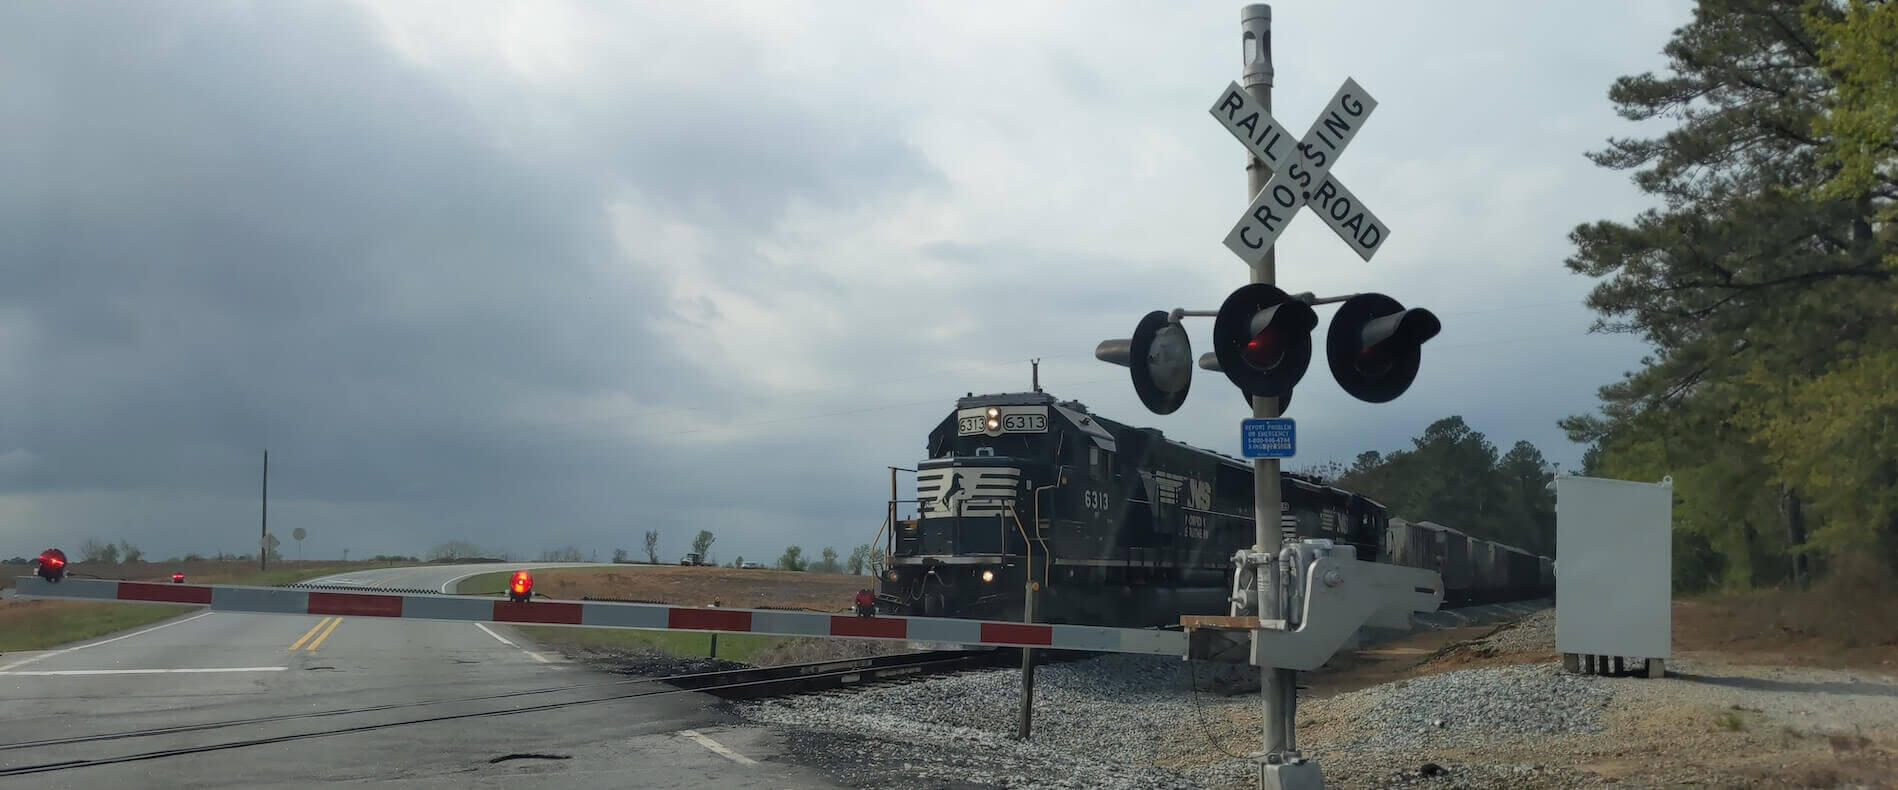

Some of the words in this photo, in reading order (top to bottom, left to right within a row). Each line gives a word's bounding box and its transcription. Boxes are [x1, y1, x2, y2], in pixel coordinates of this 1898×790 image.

[1219, 90, 1281, 162] RAIL
[1240, 94, 1363, 249] CROSSING
[1313, 180, 1381, 249] ROAD
[959, 418, 985, 432] 6313
[1005, 416, 1045, 429] 6313
[1085, 490, 1109, 510] 6313
[1187, 478, 1211, 510] NS
